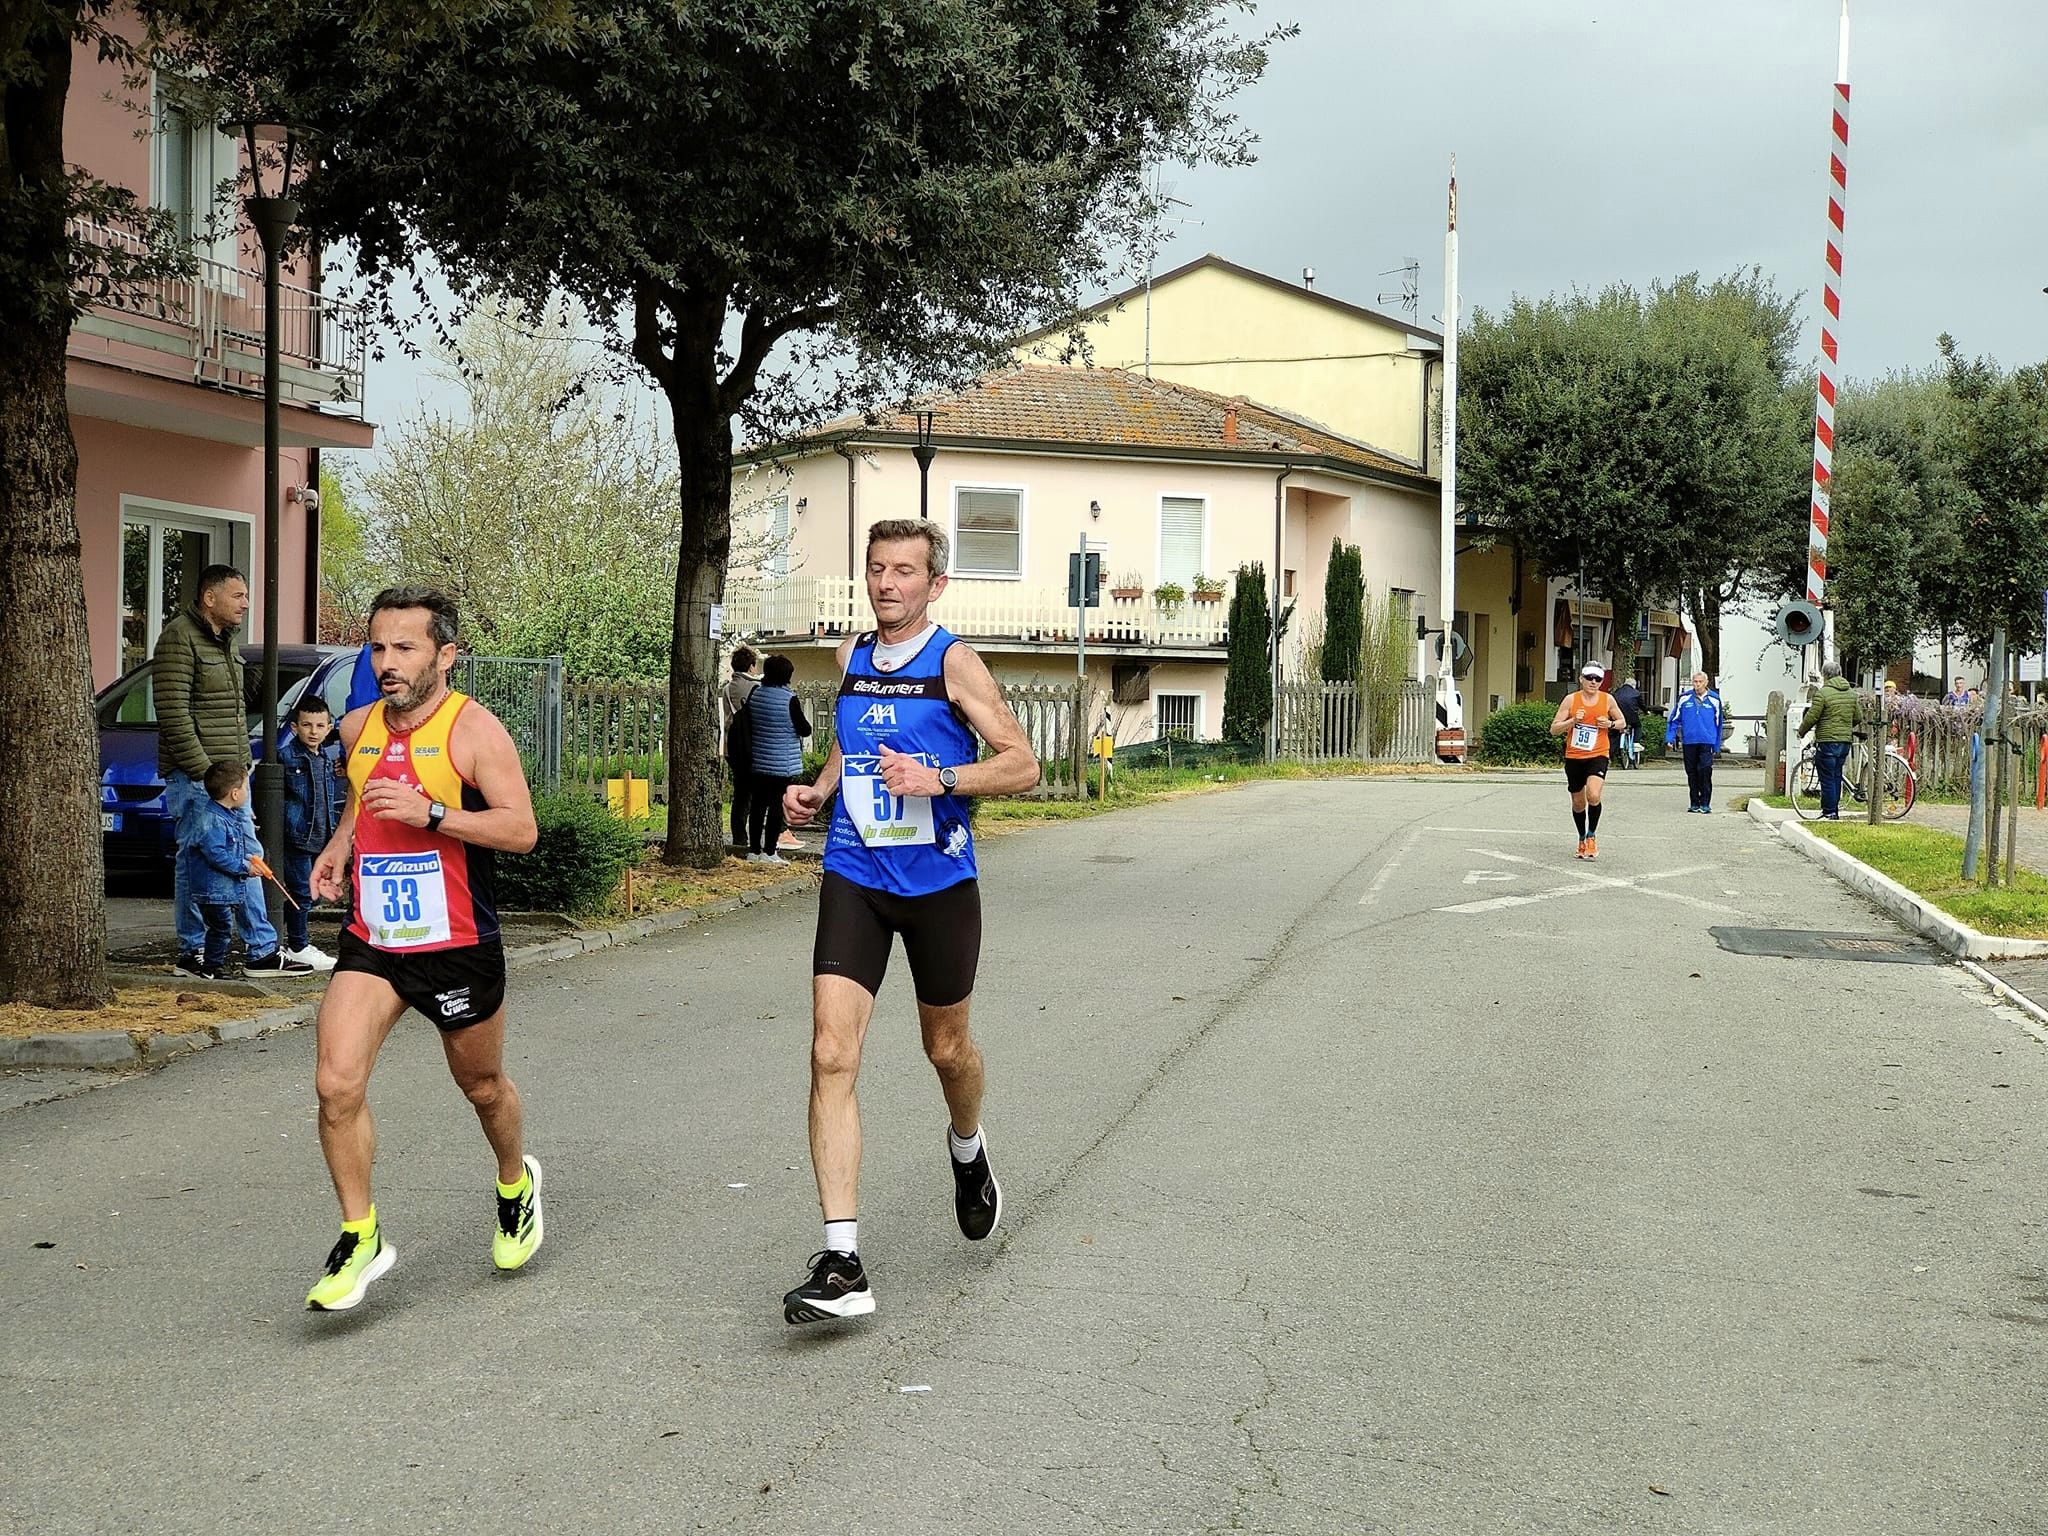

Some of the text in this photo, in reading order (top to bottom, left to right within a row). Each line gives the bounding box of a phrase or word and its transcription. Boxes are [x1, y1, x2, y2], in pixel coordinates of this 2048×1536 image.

[853, 680, 925, 695] BeRunners
[859, 703, 897, 724] AXA
[1578, 731, 1590, 743] 59
[359, 747, 381, 755] AVIS
[382, 878, 421, 922] 33
